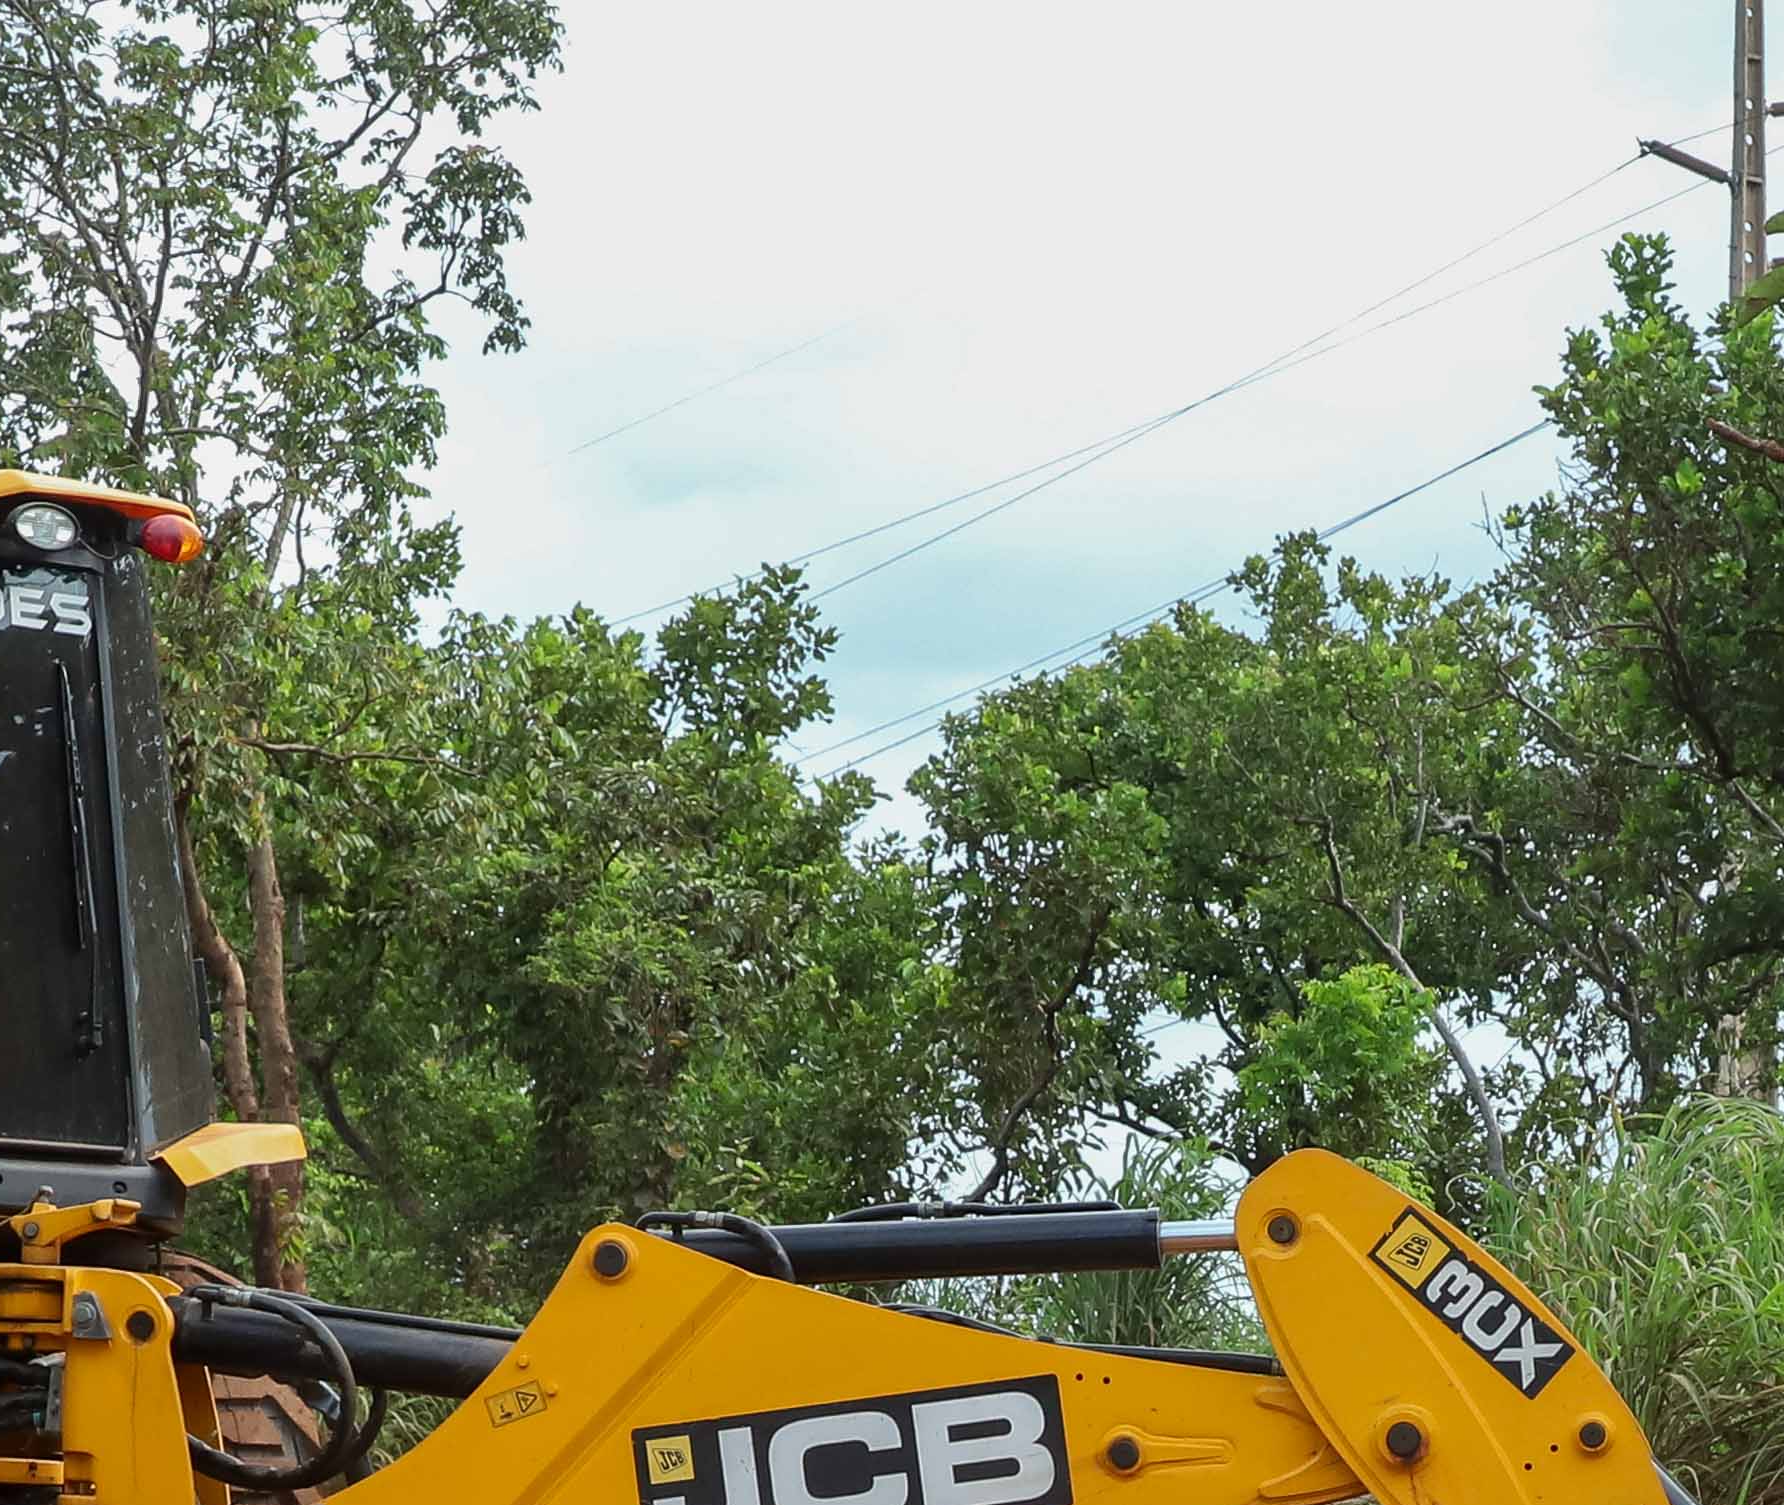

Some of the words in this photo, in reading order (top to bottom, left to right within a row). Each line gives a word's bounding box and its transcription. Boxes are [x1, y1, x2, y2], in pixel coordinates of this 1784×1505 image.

[1394, 1236, 1428, 1267] JCB
[1426, 1259, 1564, 1391] 3CX
[658, 1450, 685, 1471] JCB
